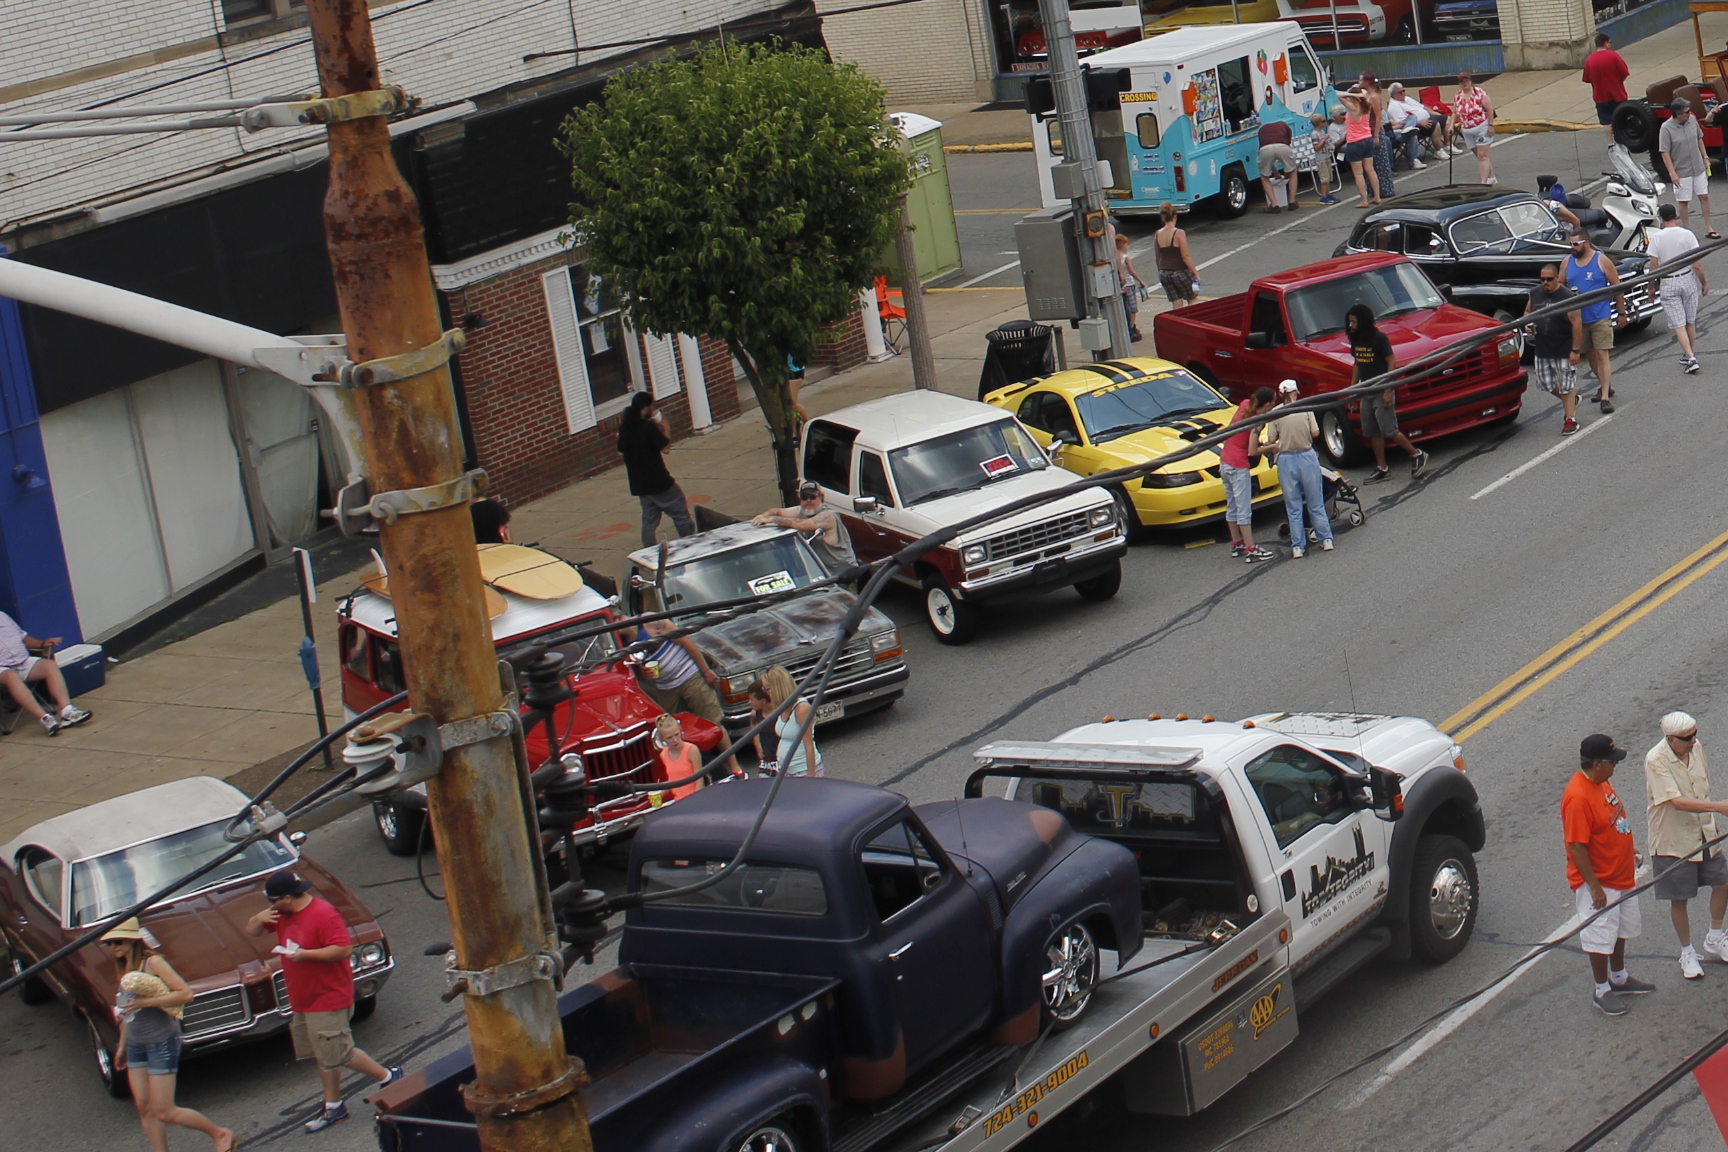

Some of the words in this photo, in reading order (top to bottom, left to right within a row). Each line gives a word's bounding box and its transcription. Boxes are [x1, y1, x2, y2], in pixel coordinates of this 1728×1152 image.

[1120, 92, 1157, 102] CROSSING
[1091, 373, 1174, 398] STEEDA
[755, 583, 771, 594] FOR
[770, 577, 790, 589] SALE
[1310, 909, 1332, 928] TOWING
[1333, 898, 1346, 912] WITH
[1346, 878, 1373, 903] INTEGRITY
[1251, 997, 1273, 1026] AAA
[983, 1050, 1089, 1139] 724-321-9004
